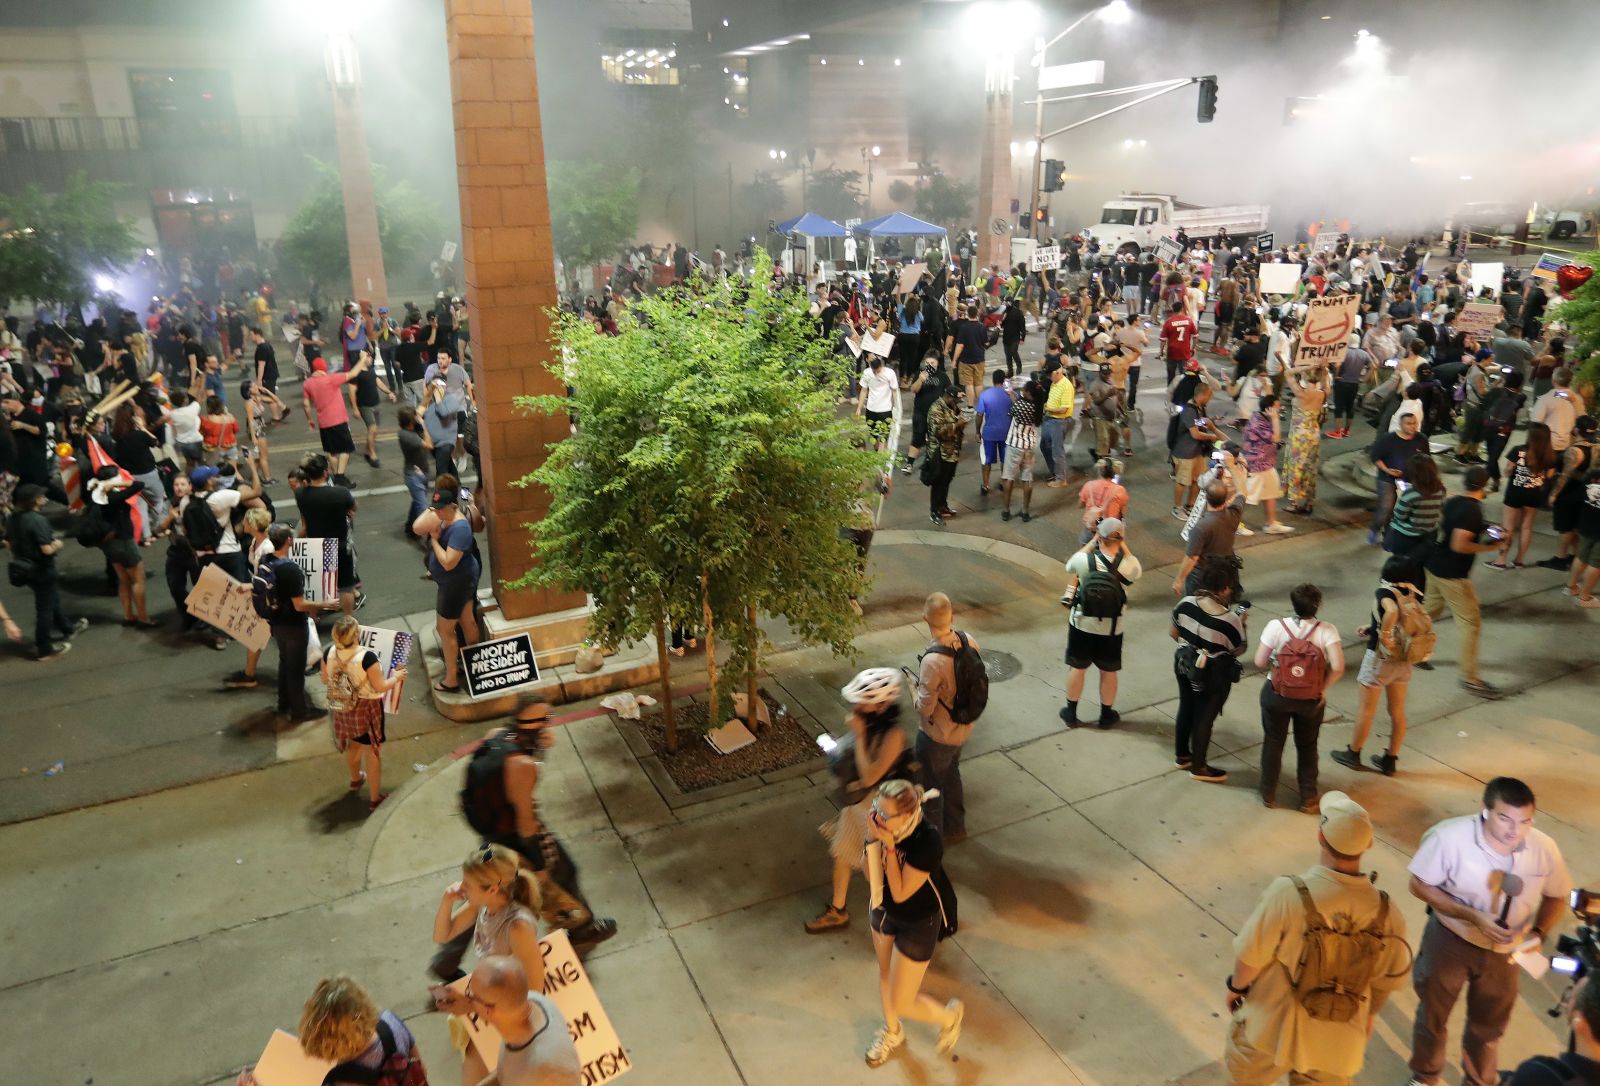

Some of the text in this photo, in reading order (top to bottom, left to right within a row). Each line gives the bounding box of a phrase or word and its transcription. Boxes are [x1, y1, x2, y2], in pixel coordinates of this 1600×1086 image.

[1036, 254, 1055, 263] NOT
[1176, 326, 1185, 341] 7
[1300, 342, 1347, 359] TRUMP
[291, 542, 307, 556] WE
[471, 650, 528, 675] PRESIDENT
[494, 676, 507, 686] TO
[505, 669, 531, 684] TRUMP
